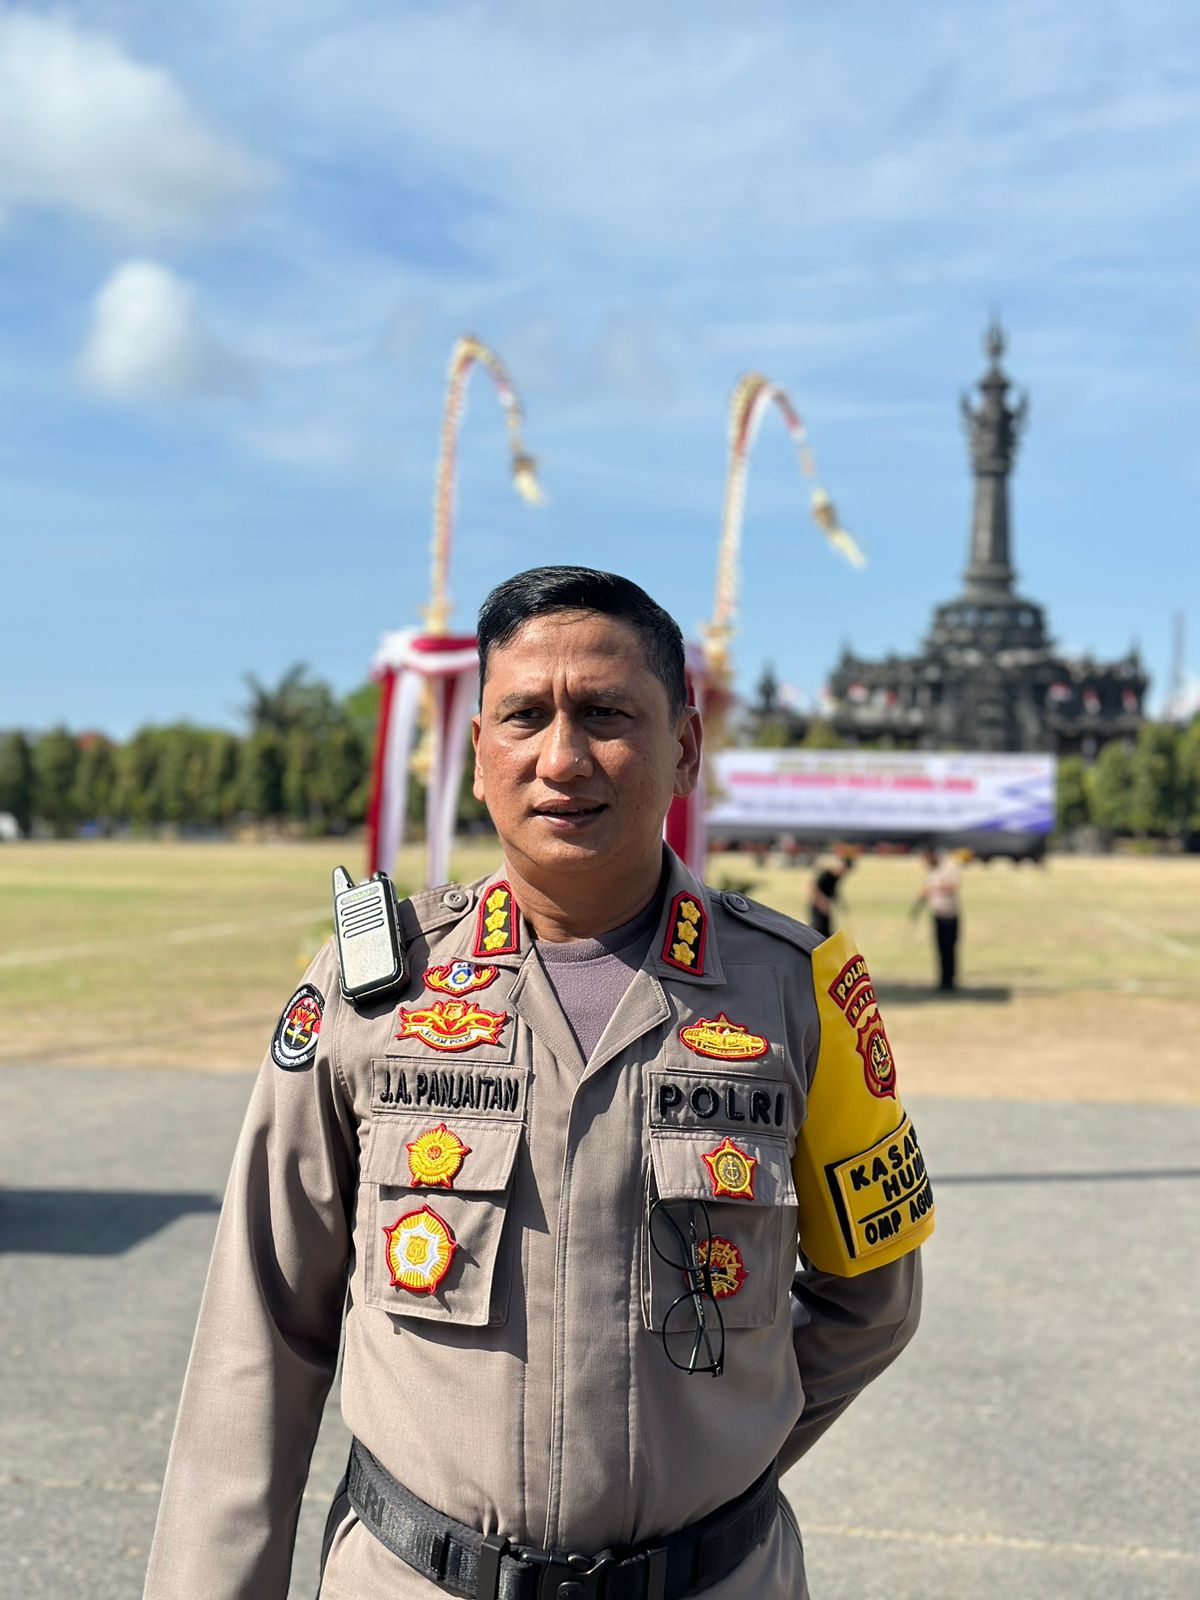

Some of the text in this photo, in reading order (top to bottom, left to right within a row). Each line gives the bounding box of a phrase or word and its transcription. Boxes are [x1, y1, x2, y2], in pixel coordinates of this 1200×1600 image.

[379, 1070, 520, 1113] J.A. PANJAITAN
[658, 1083, 785, 1127] POLRI
[865, 1209, 902, 1245] OMP
